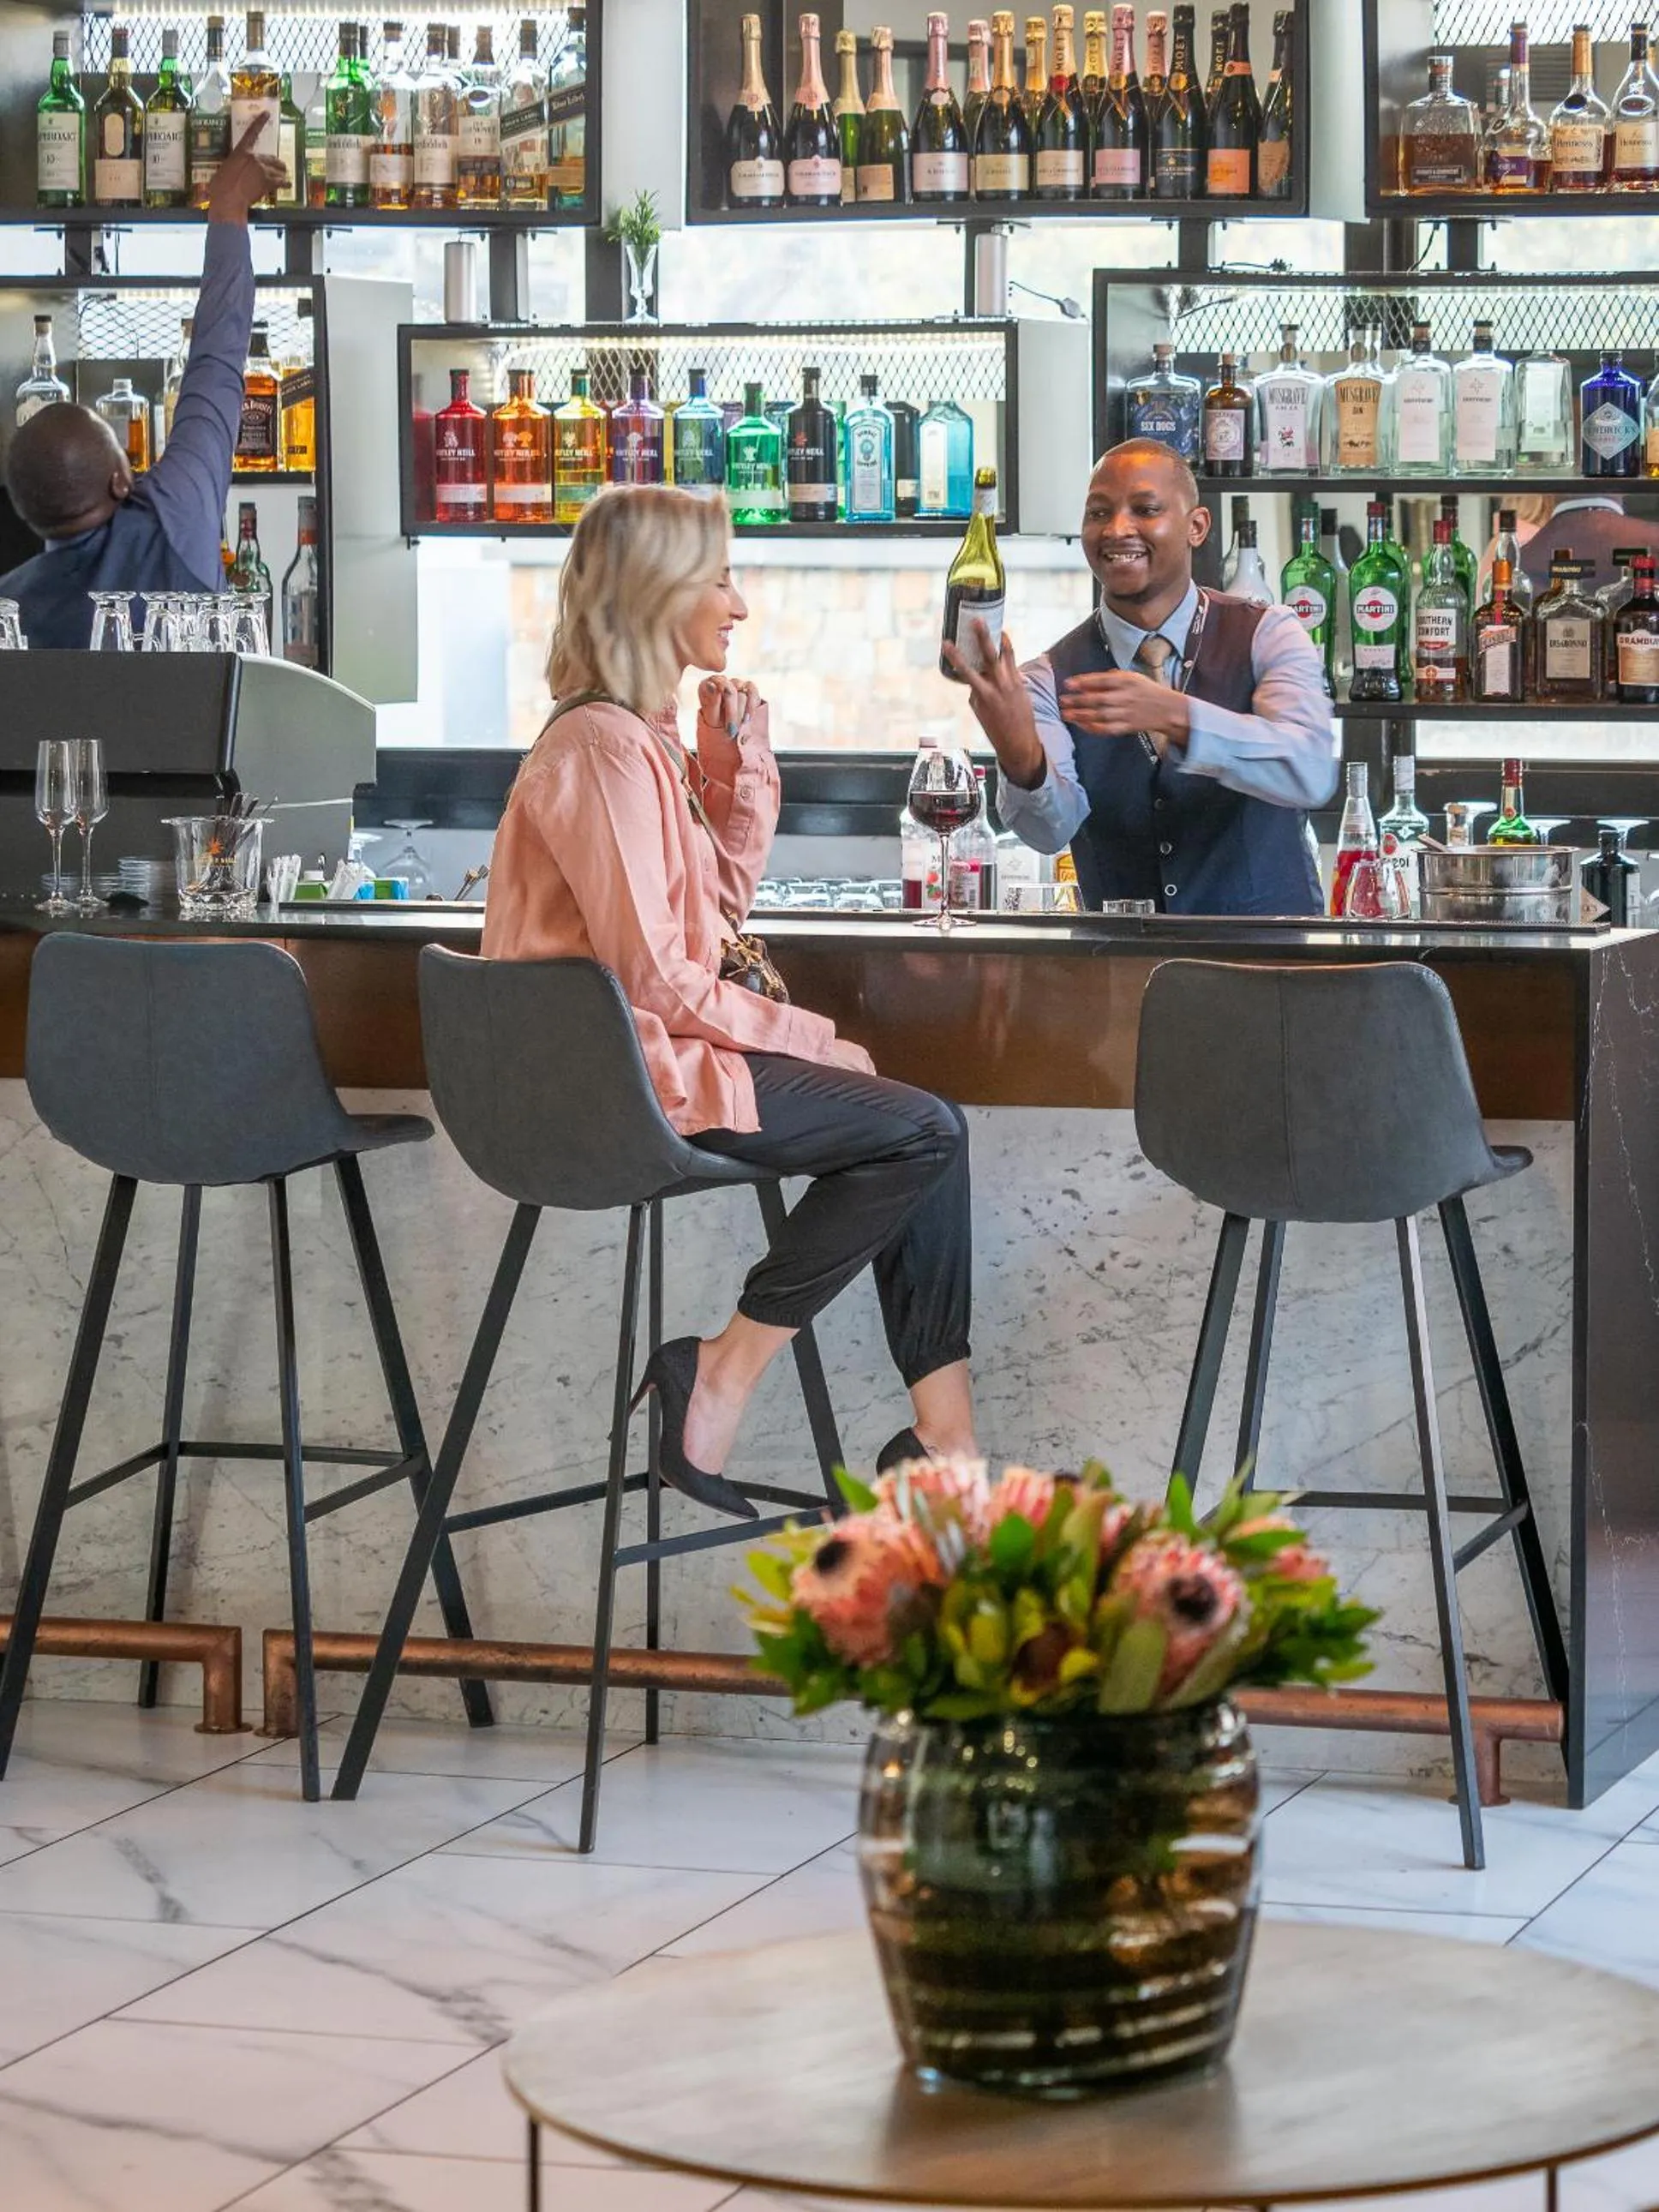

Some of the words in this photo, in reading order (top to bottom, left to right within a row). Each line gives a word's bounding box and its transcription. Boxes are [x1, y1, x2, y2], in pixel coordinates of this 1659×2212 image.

[1155, 421, 1177, 431] DOGS
[1418, 616, 1453, 626] SOUTHERN
[1418, 626, 1450, 636] COMFORT
